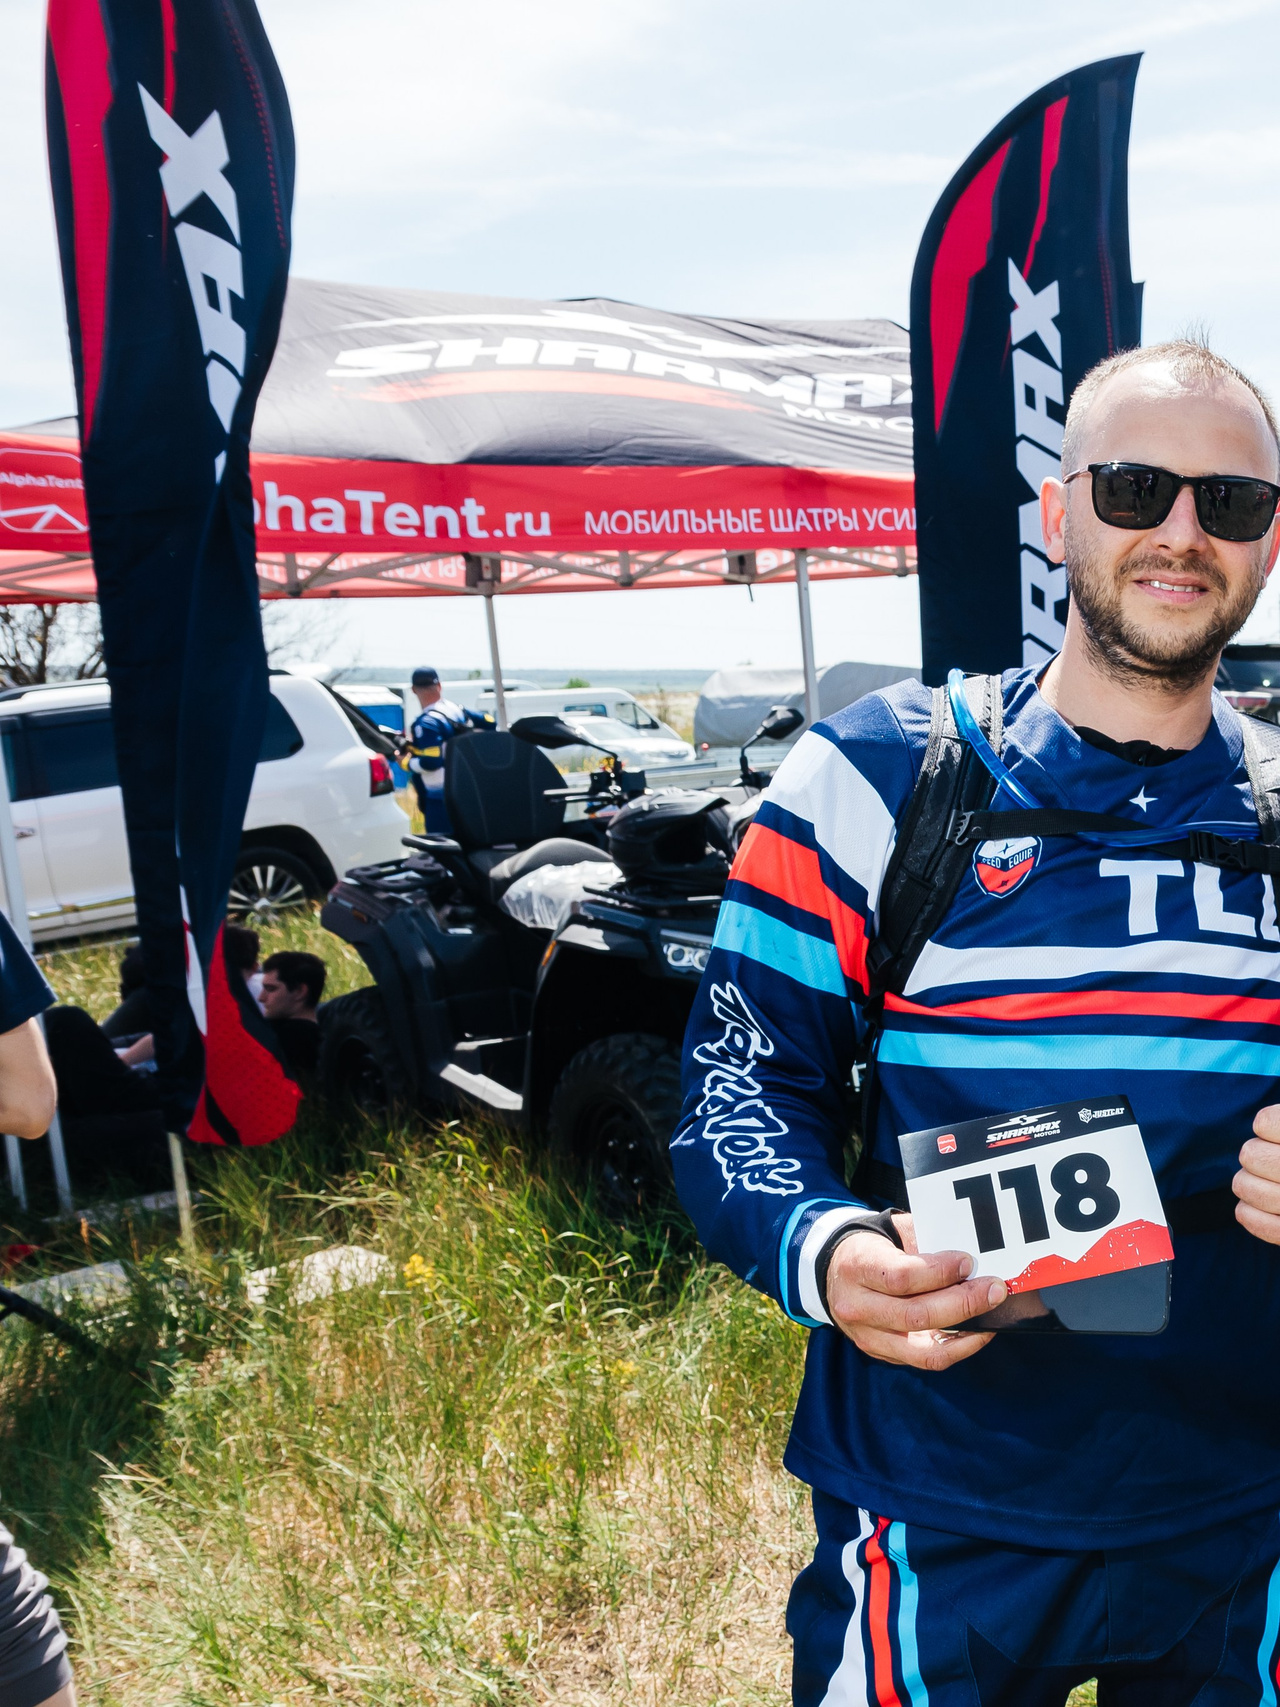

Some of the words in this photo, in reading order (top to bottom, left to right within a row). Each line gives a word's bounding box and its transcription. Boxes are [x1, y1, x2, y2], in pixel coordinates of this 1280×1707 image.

[584, 508, 765, 536] МОБИЛЬНЫЕ
[769, 507, 859, 533] ШАТРЫ
[985, 1120, 1061, 1143] SHARMAX
[1034, 1128, 1061, 1138] MOTORS
[952, 1152, 1121, 1254] 118
